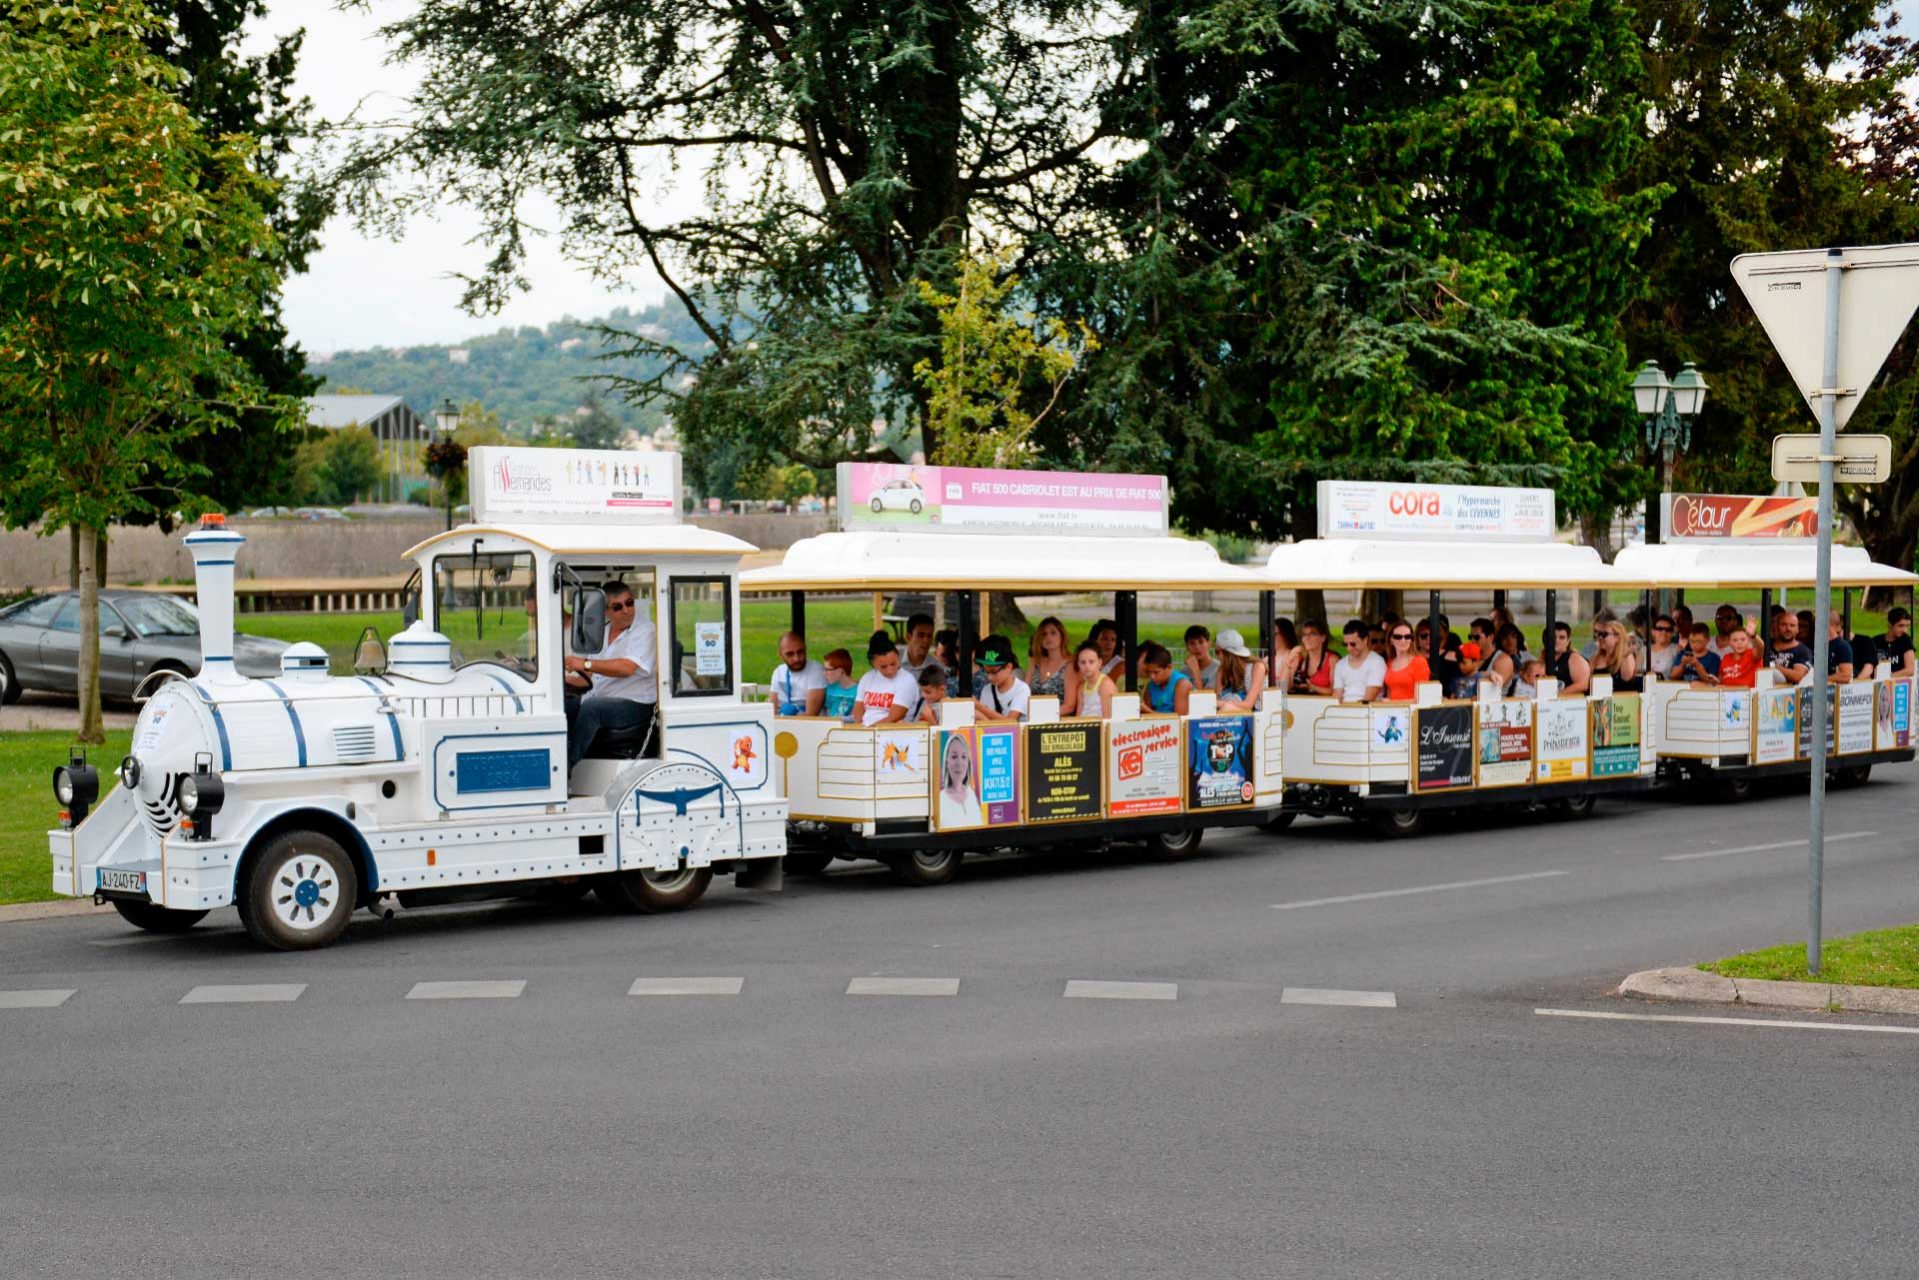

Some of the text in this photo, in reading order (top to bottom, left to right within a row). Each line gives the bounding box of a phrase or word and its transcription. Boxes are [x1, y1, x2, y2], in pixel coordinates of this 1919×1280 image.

[971, 482, 1162, 501] FIAT 500 CABRIOLET EST AU PRIX DE FIAT 500
[1389, 490, 1440, 516] cora
[1672, 495, 1731, 537] Célaur
[1112, 724, 1172, 747] electronique
[1145, 735, 1178, 754] service
